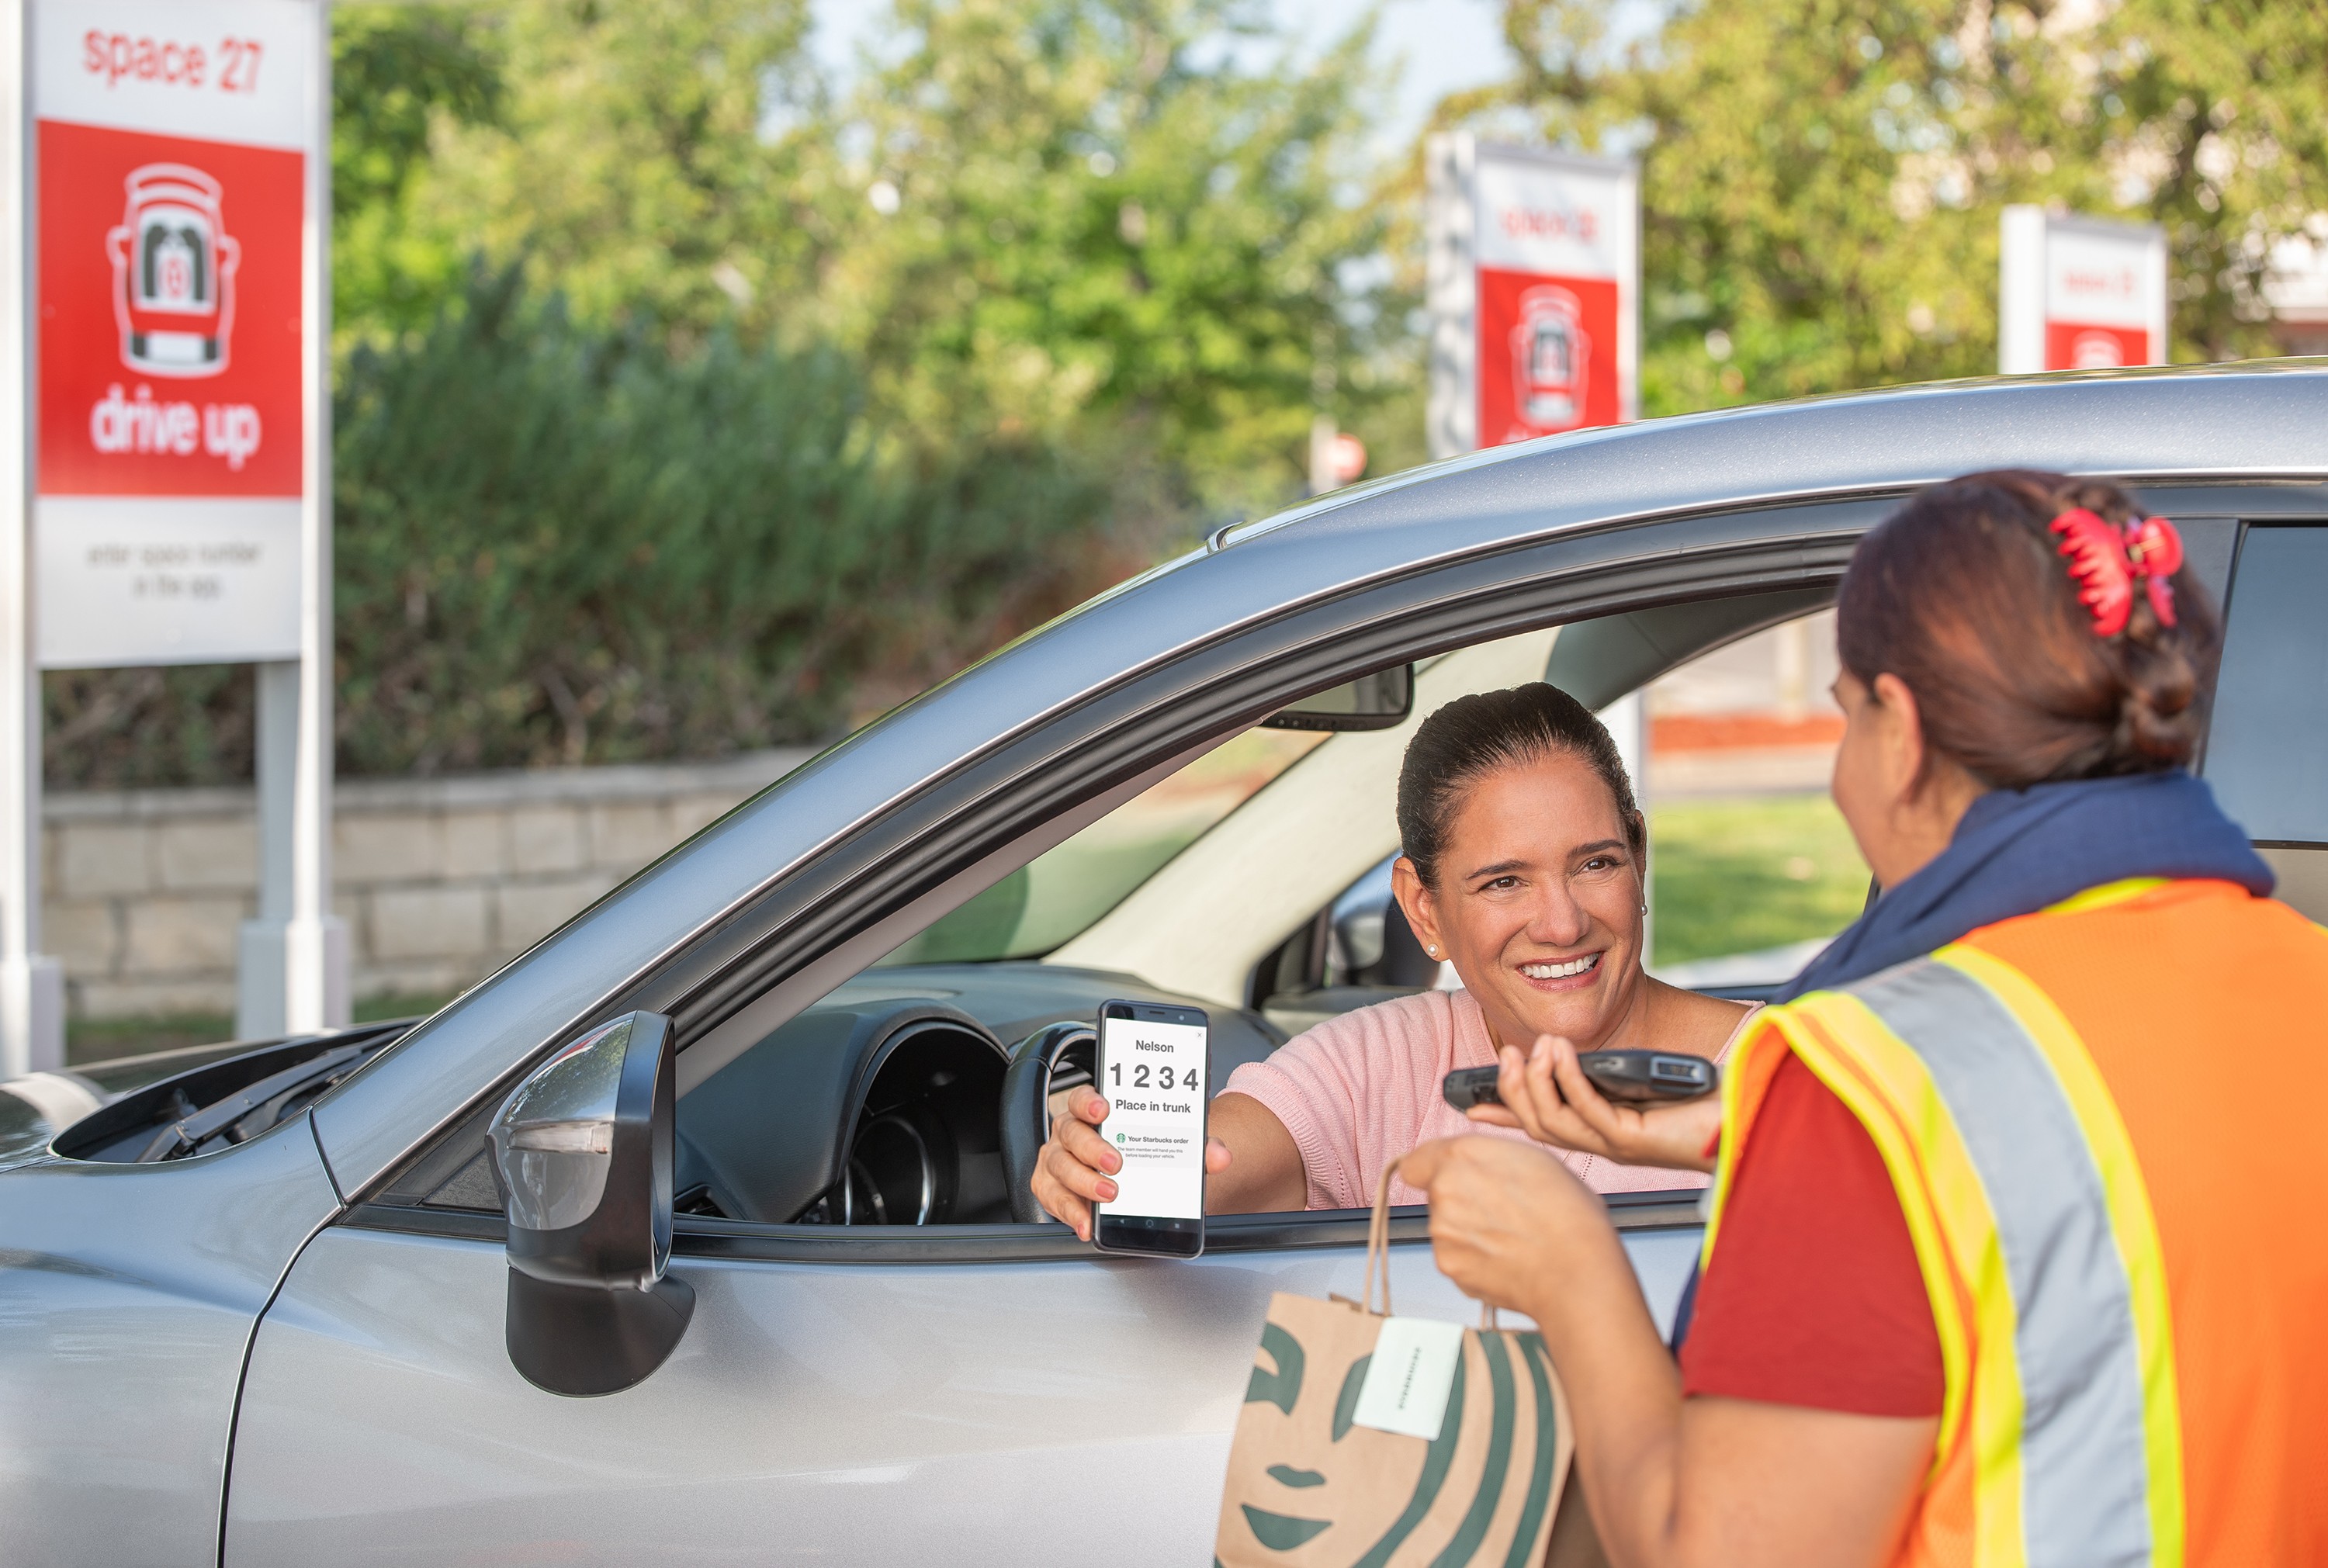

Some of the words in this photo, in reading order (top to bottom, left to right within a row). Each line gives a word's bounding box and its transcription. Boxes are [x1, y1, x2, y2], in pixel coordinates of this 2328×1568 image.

[84, 29, 206, 90] space
[218, 36, 264, 95] 27
[89, 382, 200, 455] drive
[203, 402, 262, 471] up
[1135, 1040, 1174, 1053] Nelson
[1115, 1099, 1147, 1111] Place
[1149, 1101, 1159, 1111] in
[1162, 1102, 1191, 1113] trunk
